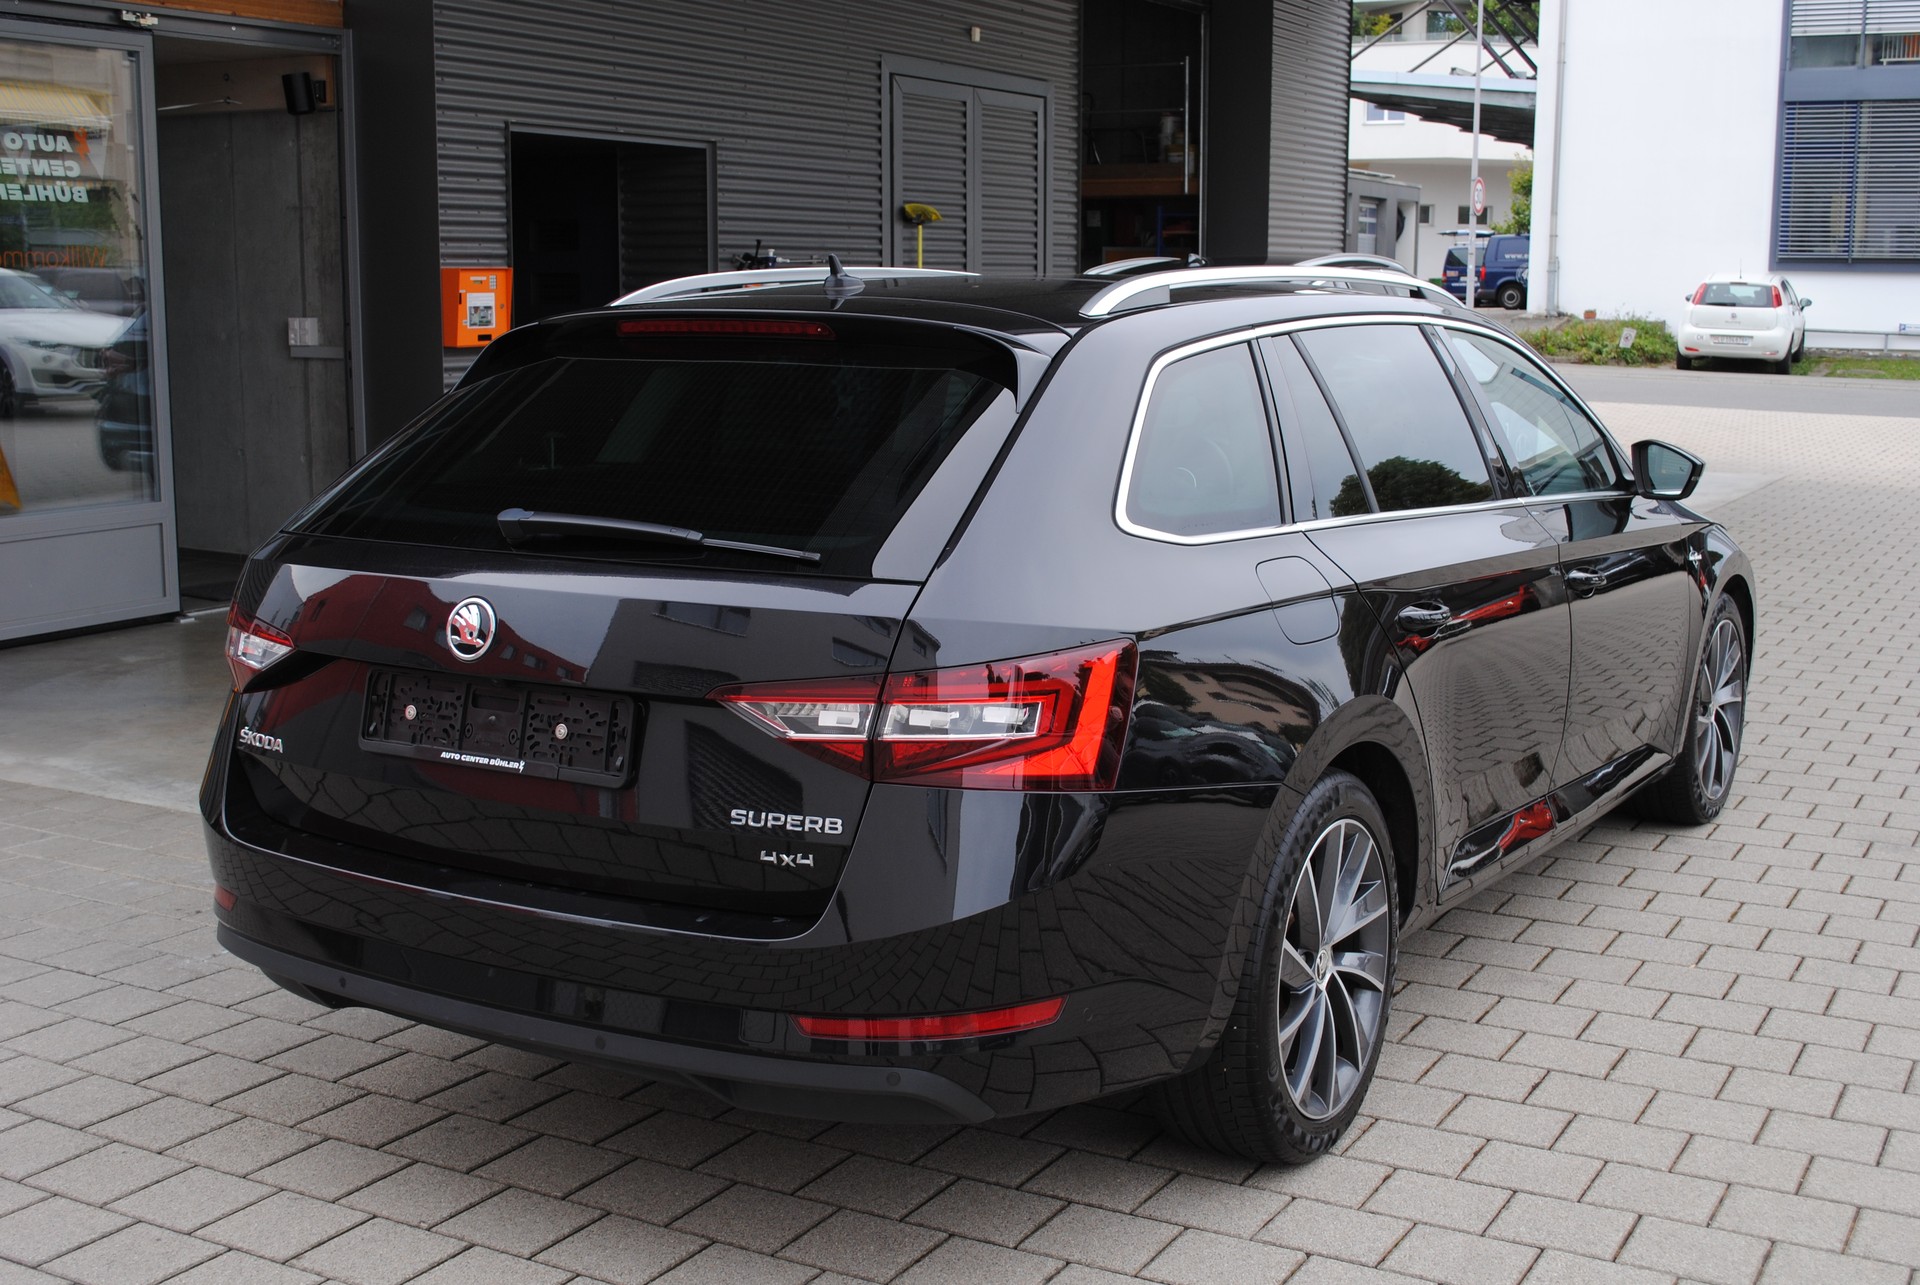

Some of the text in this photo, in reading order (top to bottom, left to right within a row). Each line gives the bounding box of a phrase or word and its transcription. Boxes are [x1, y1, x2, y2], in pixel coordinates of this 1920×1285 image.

[239, 726, 283, 753] ŠKODA
[440, 751, 520, 769] AUTO CENTER BÜHLER
[730, 808, 843, 835] SUPERB
